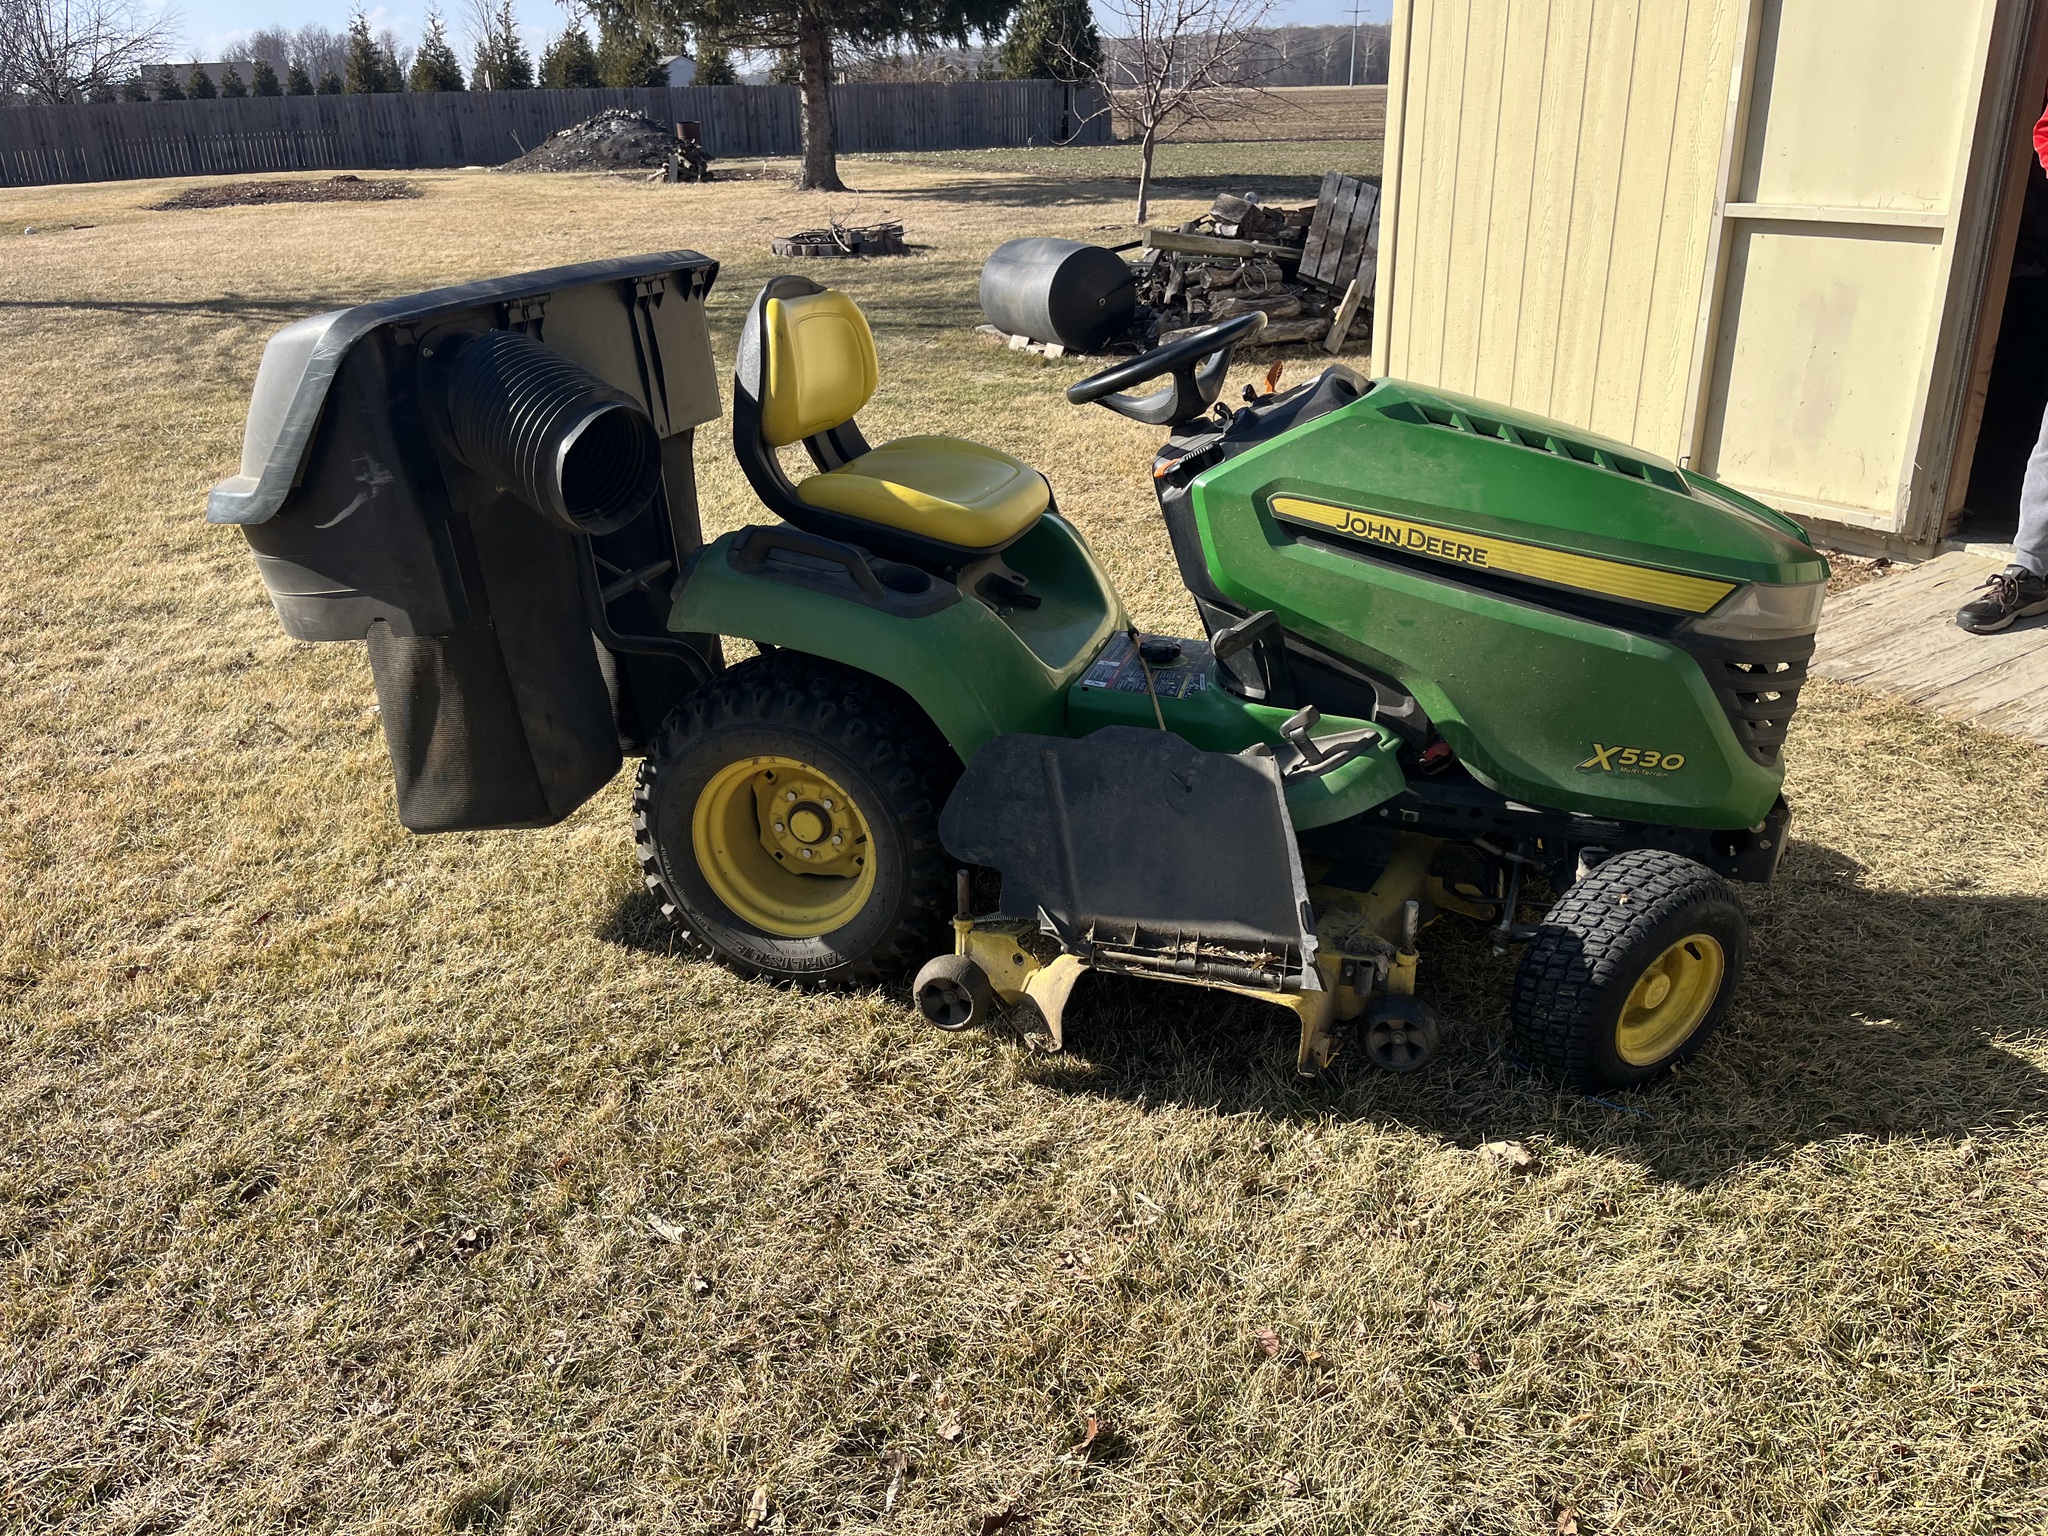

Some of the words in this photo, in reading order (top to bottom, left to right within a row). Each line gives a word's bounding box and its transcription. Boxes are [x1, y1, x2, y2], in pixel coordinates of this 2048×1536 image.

[1336, 512, 1401, 546] JOHN
[1407, 528, 1488, 566] DEERE
[1578, 743, 1686, 771] X530
